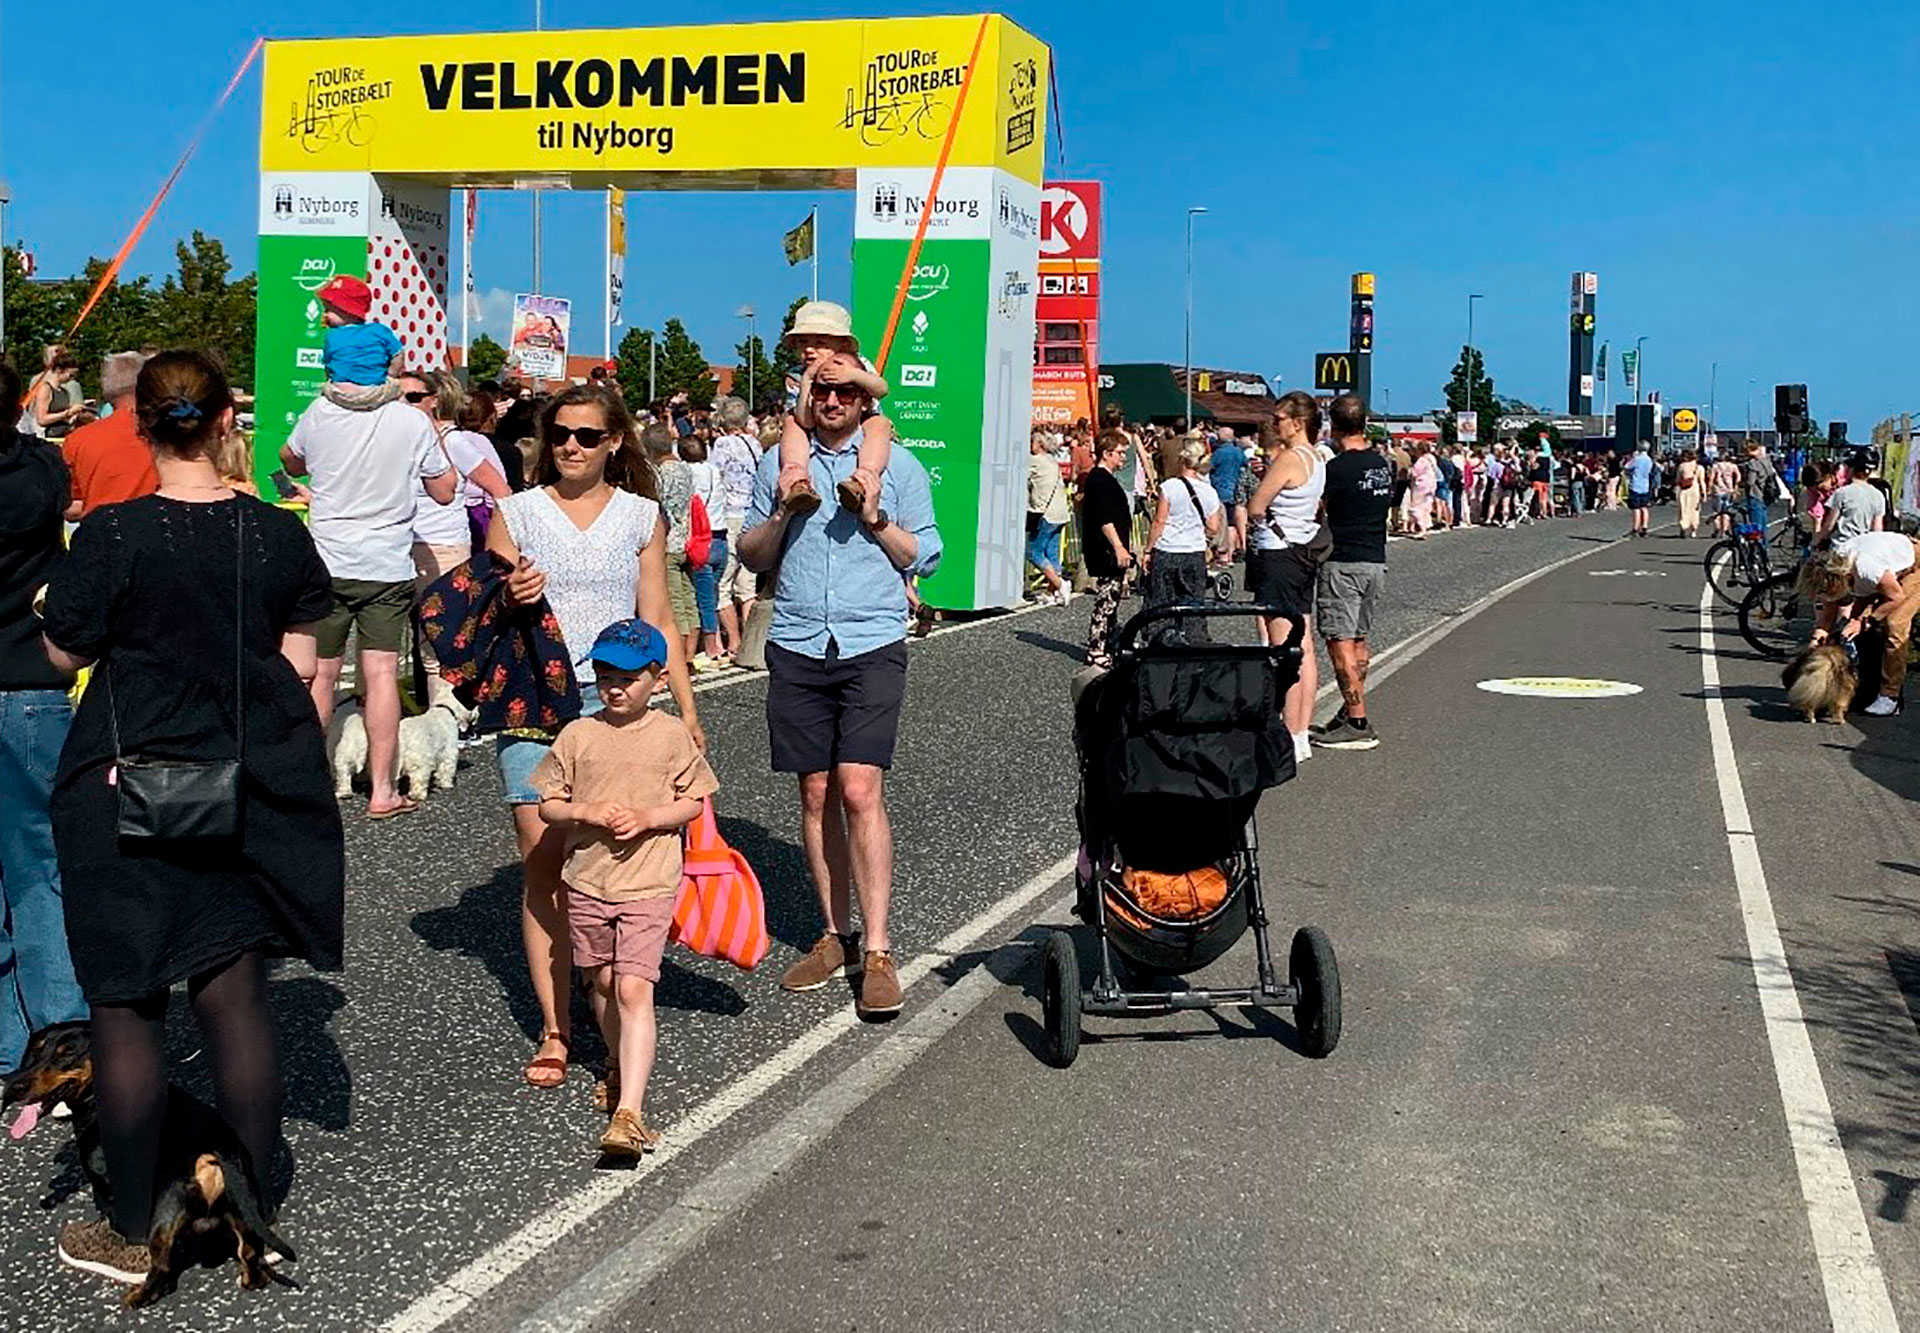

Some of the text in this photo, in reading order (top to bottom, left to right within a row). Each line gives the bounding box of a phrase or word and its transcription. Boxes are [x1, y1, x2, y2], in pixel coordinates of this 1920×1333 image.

[876, 49, 938, 73] TOUR DE
[315, 67, 366, 88] TOUR DE
[420, 52, 805, 111] VELKOMMEN
[879, 65, 969, 98] STOREBÆL
[316, 81, 393, 110] STOREBÆLT
[537, 121, 674, 155] til Nyborg
[299, 196, 360, 218] Nyborg
[399, 202, 444, 230] Nyborg
[1041, 201, 1081, 244] K
[302, 258, 329, 270] DCU
[905, 370, 932, 382] DGI
[902, 436, 946, 449] ŠKODA
